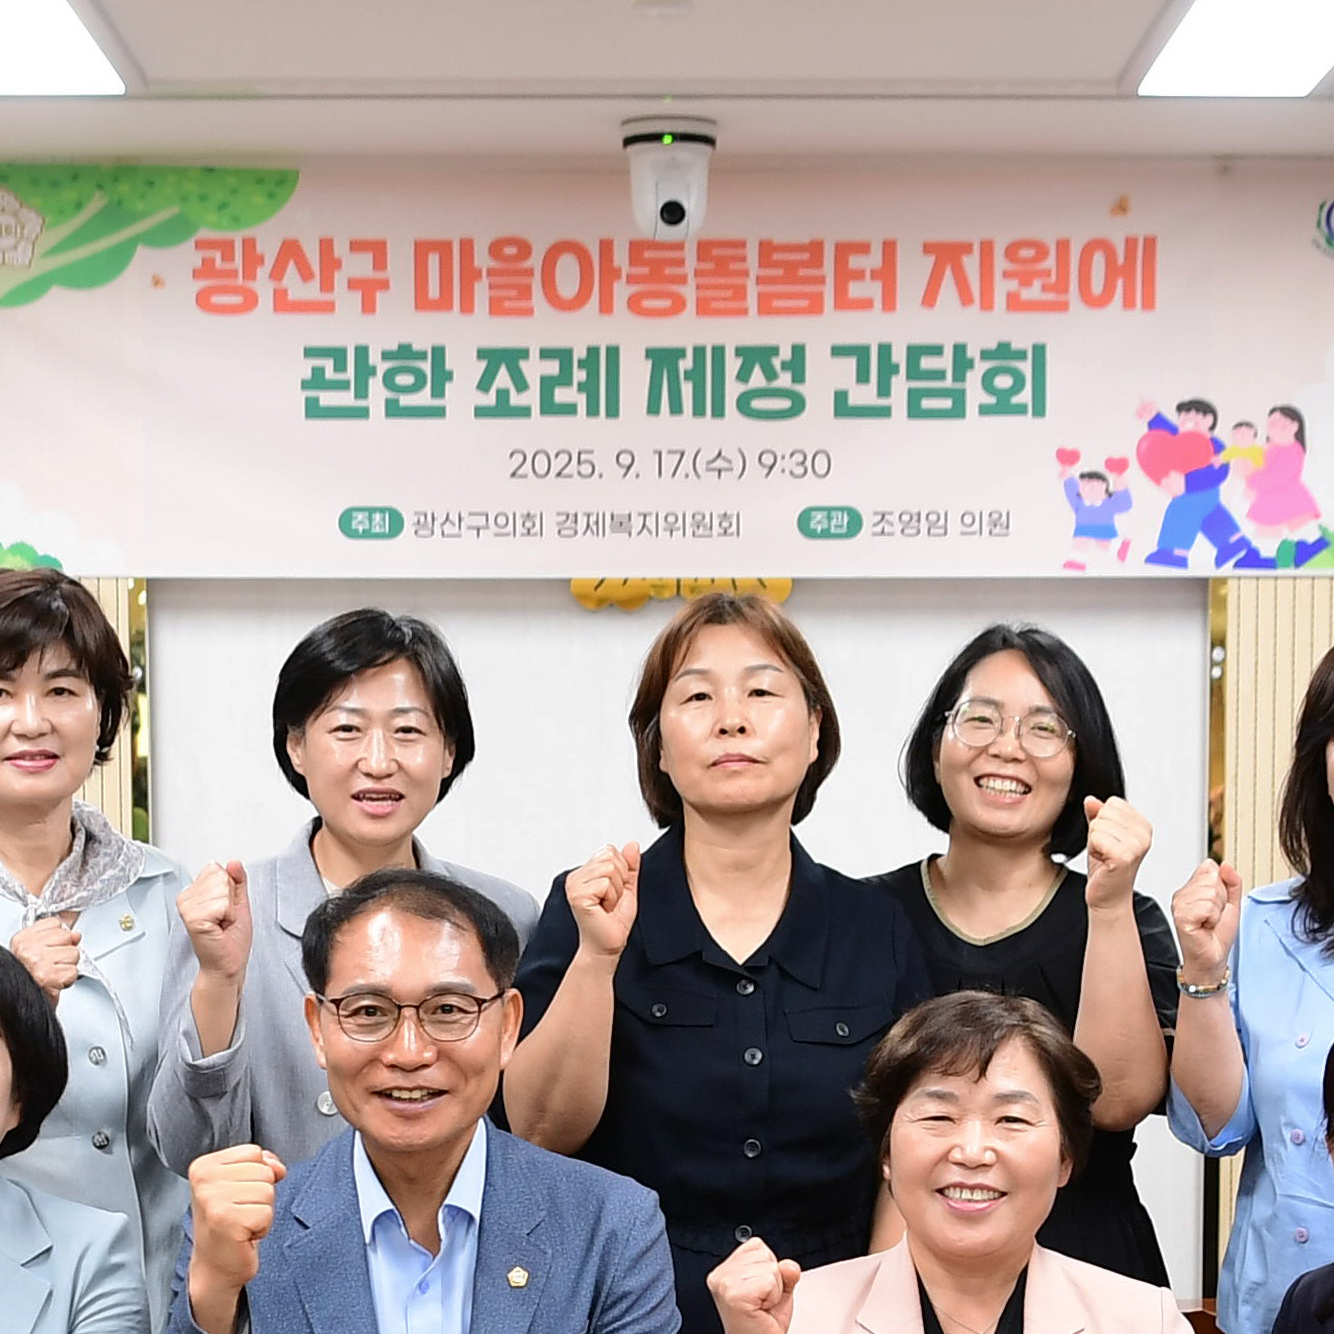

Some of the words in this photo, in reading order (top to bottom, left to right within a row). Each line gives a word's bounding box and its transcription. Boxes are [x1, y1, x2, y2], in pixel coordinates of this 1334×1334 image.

[192, 236, 392, 316] 광산구
[413, 235, 899, 319] 마을아동돌봄터
[921, 235, 1158, 313] 지원에
[300, 343, 454, 420] 관한
[474, 345, 620, 419] 조례
[645, 343, 807, 420] 제정
[830, 341, 1047, 419] 간담회
[508, 447, 604, 480] 2025.
[615, 447, 641, 480] 9.
[652, 447, 747, 480] 17.(수)
[757, 447, 832, 480] 9:30
[351, 510, 390, 534] 주최
[412, 510, 544, 538] 광산구의회
[556, 511, 741, 538] 경제복지위원회
[808, 510, 848, 534] 주관
[871, 509, 948, 537] 조영임
[959, 509, 1010, 537] 의원
